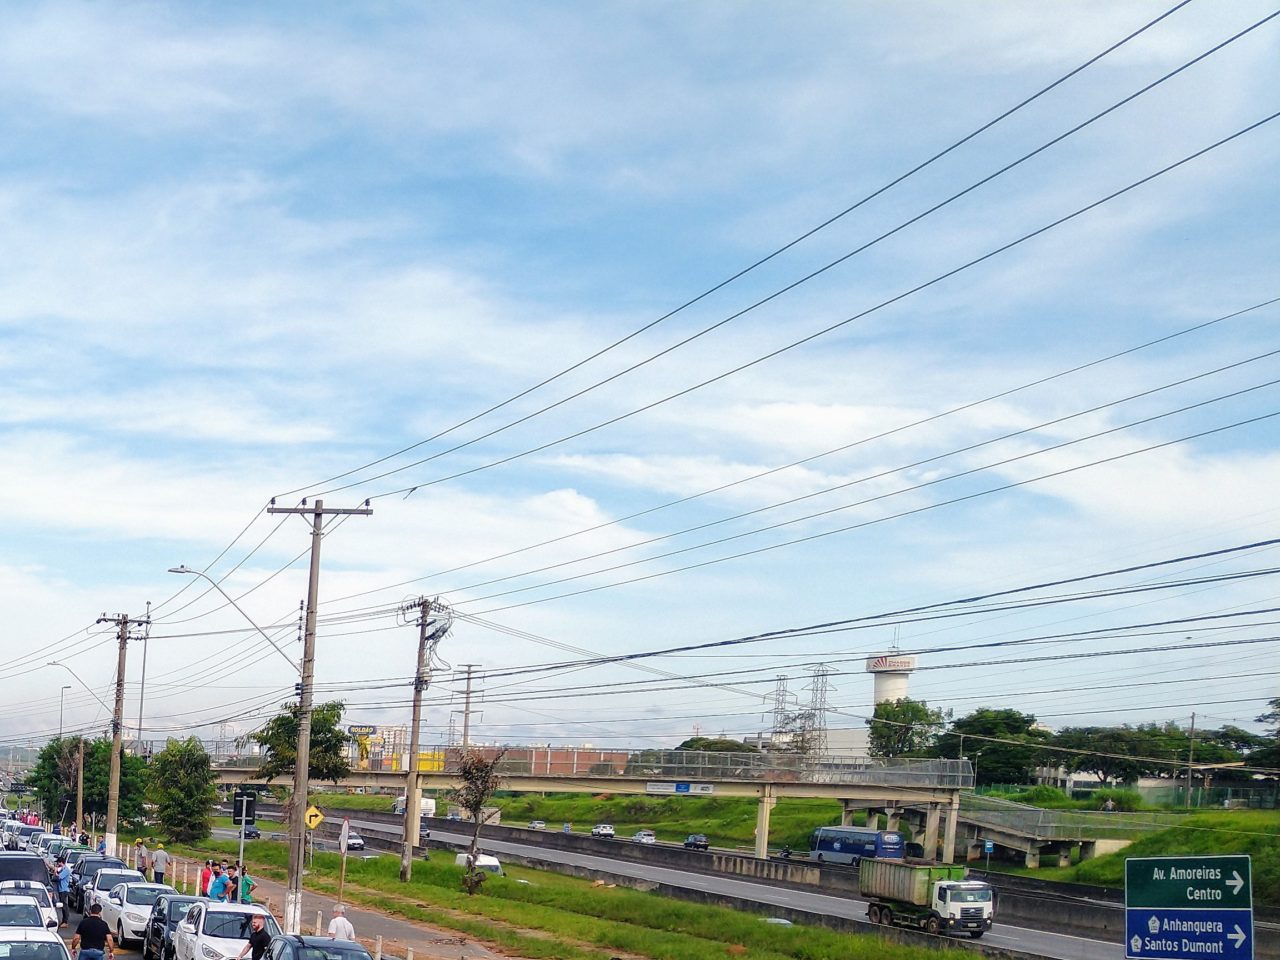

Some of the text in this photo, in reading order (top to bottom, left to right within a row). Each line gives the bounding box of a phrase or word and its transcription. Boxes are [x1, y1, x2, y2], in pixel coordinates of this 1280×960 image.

[1153, 865, 1222, 880] Av. Amoreiras
[1186, 886, 1222, 900] Centro
[1162, 918, 1223, 936] Anhanguera
[1144, 937, 1179, 952] Santos
[1182, 938, 1224, 953] Dumont
